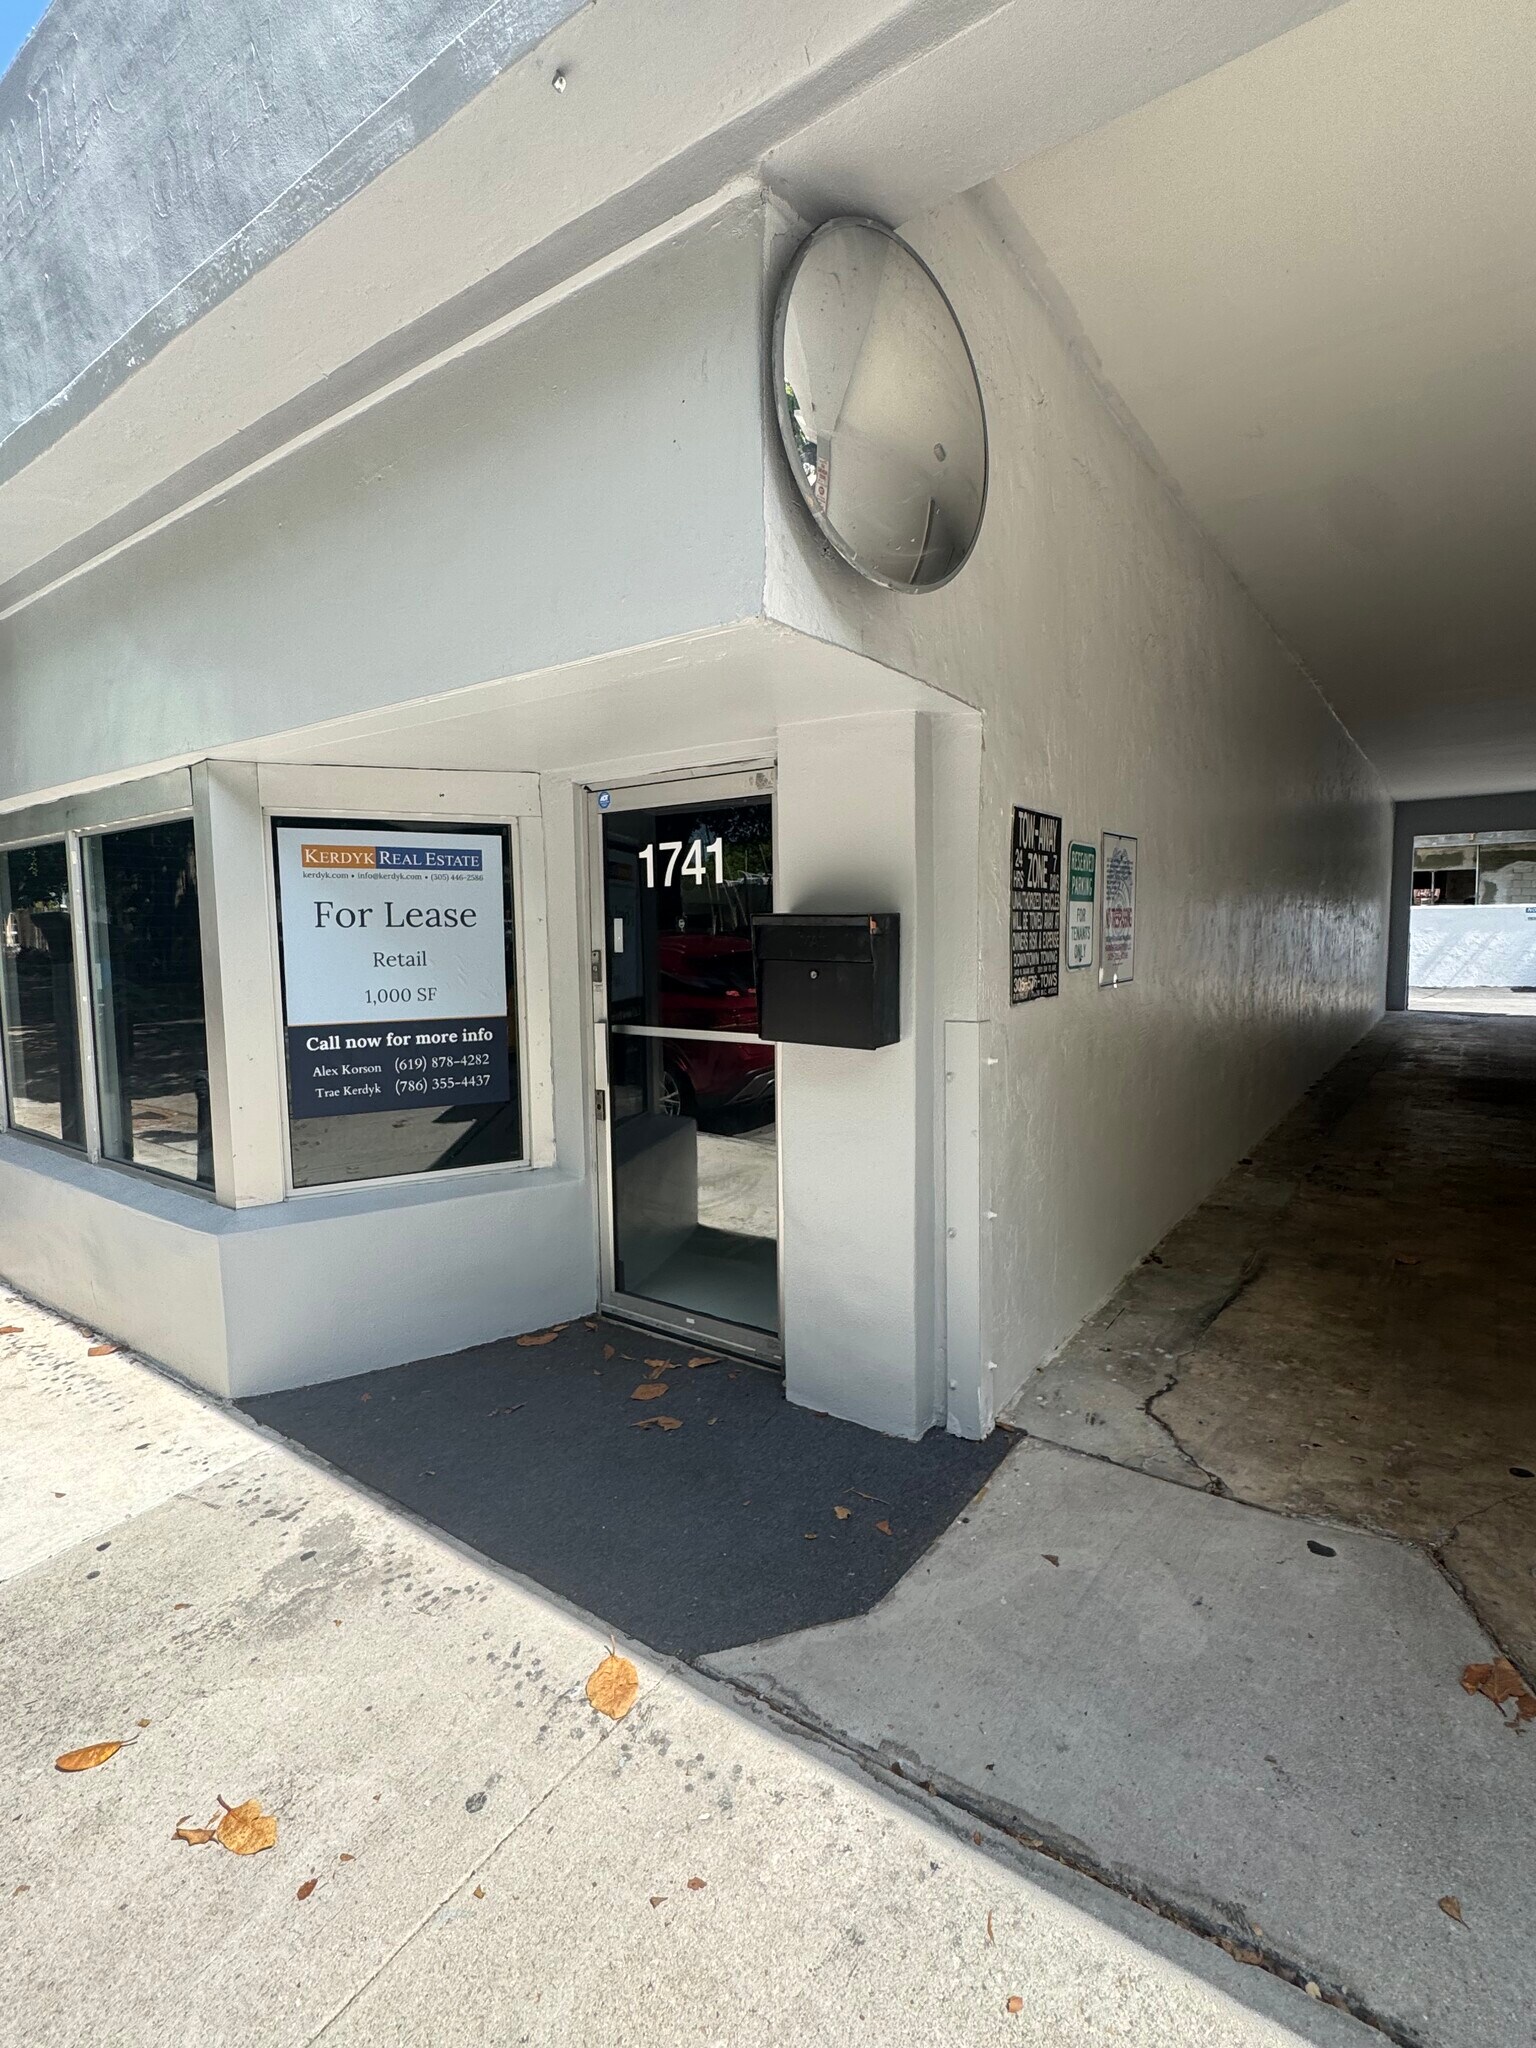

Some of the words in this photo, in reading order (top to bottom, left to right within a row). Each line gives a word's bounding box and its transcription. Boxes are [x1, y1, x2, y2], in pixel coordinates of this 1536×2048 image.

[1018, 810, 1058, 853] TOW-AWAY
[304, 848, 375, 865] KERDYK
[379, 850, 422, 866] REAL
[425, 852, 480, 867] ESTATE
[638, 837, 724, 888] 1741
[1071, 850, 1095, 873] RESERVED
[302, 871, 349, 880] kerdyk.com
[358, 872, 422, 881] info@kerdyk.com
[431, 874, 450, 882] (305)
[1015, 848, 1024, 868] 24
[1027, 852, 1049, 889] ZONE
[1052, 854, 1058, 873] 7
[1013, 869, 1024, 889] HRS
[1071, 875, 1093, 896] PARKING
[314, 901, 374, 929] For
[383, 901, 477, 928] Lease
[1022, 912, 1029, 930] BE
[1076, 907, 1086, 923] FOR
[1071, 926, 1091, 941] TENANTS
[373, 950, 427, 968] Retail
[1074, 943, 1087, 960] ONLY
[365, 988, 412, 1006] 1,000
[417, 987, 438, 1002] SF
[306, 1036, 341, 1052] Call
[345, 1036, 382, 1050] now
[386, 1032, 411, 1047] for
[415, 1031, 458, 1045] more
[462, 1027, 494, 1042] info
[312, 1065, 339, 1078] Alex
[342, 1063, 382, 1075] Korson
[394, 1055, 428, 1074] (619)
[431, 1053, 490, 1069] 878-4282
[315, 1087, 341, 1099] Trae
[343, 1082, 382, 1097] Kerdyk
[395, 1077, 428, 1096] (786)
[432, 1074, 491, 1090] 355-4437
